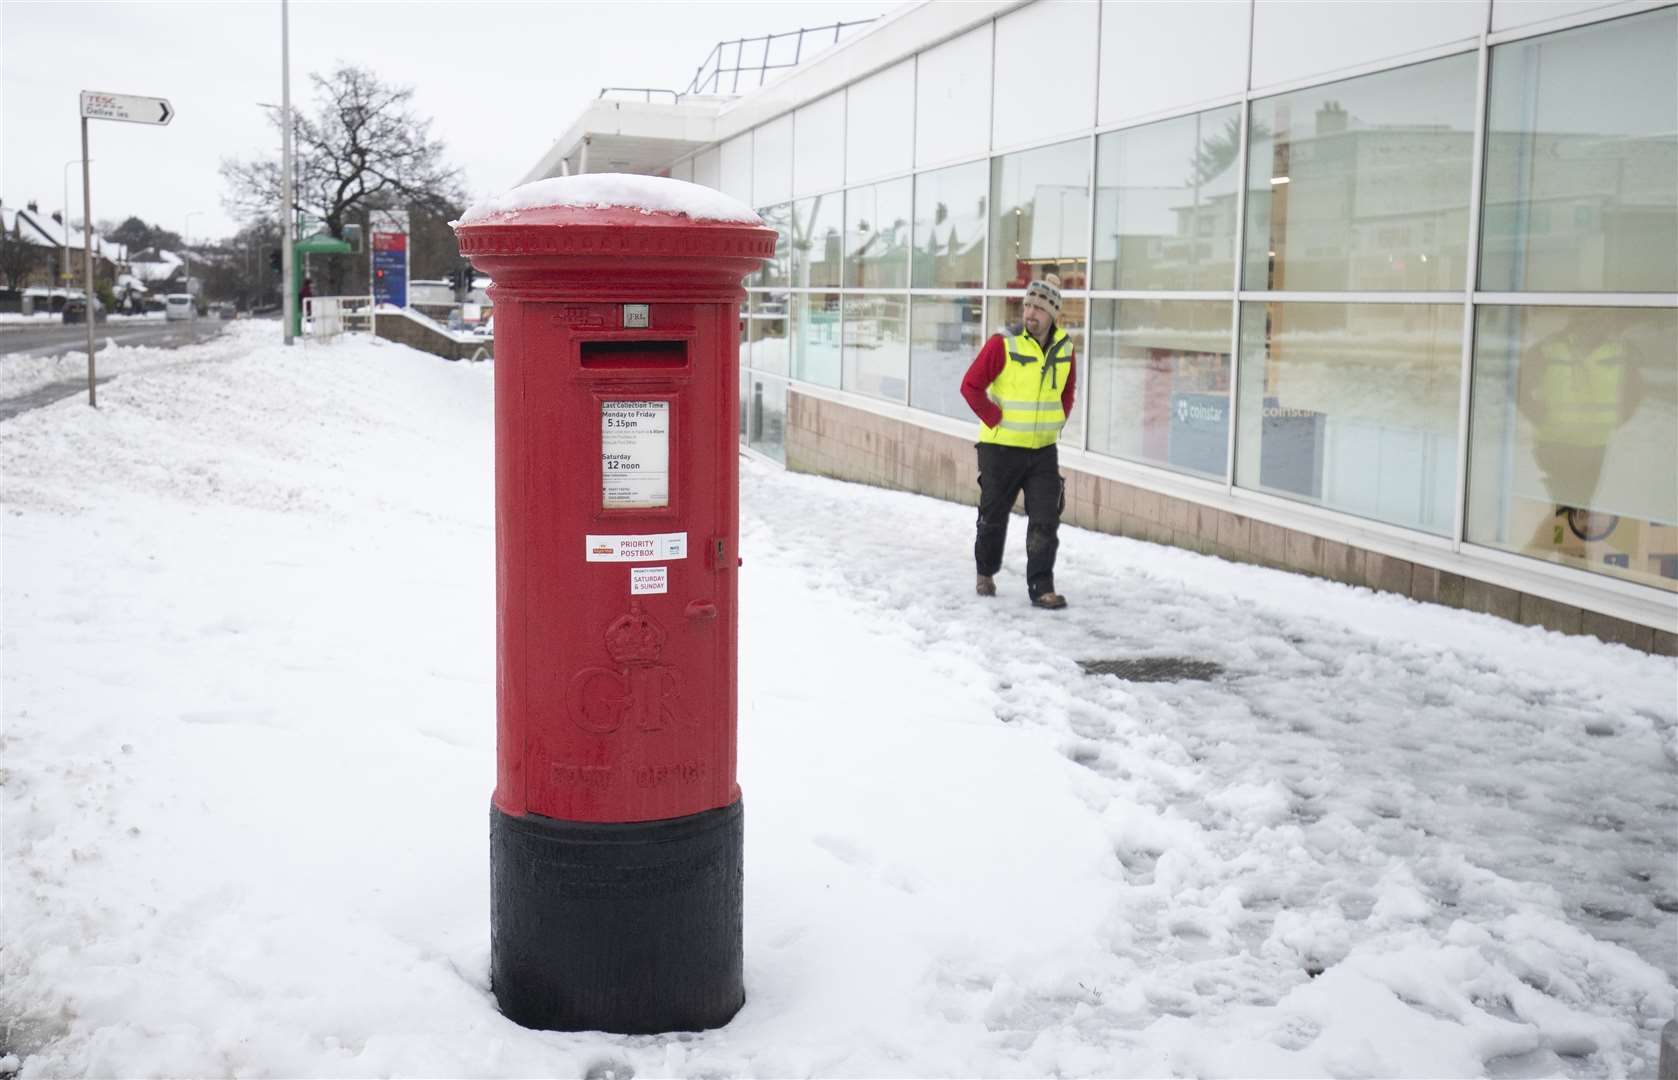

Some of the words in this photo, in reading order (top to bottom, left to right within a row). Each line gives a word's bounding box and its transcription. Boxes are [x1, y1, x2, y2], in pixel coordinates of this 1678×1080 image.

[86, 106, 128, 118] Deliveies
[1189, 402, 1223, 421] coinstar
[607, 418, 638, 428] 5.15pm
[607, 460, 619, 470] 12
